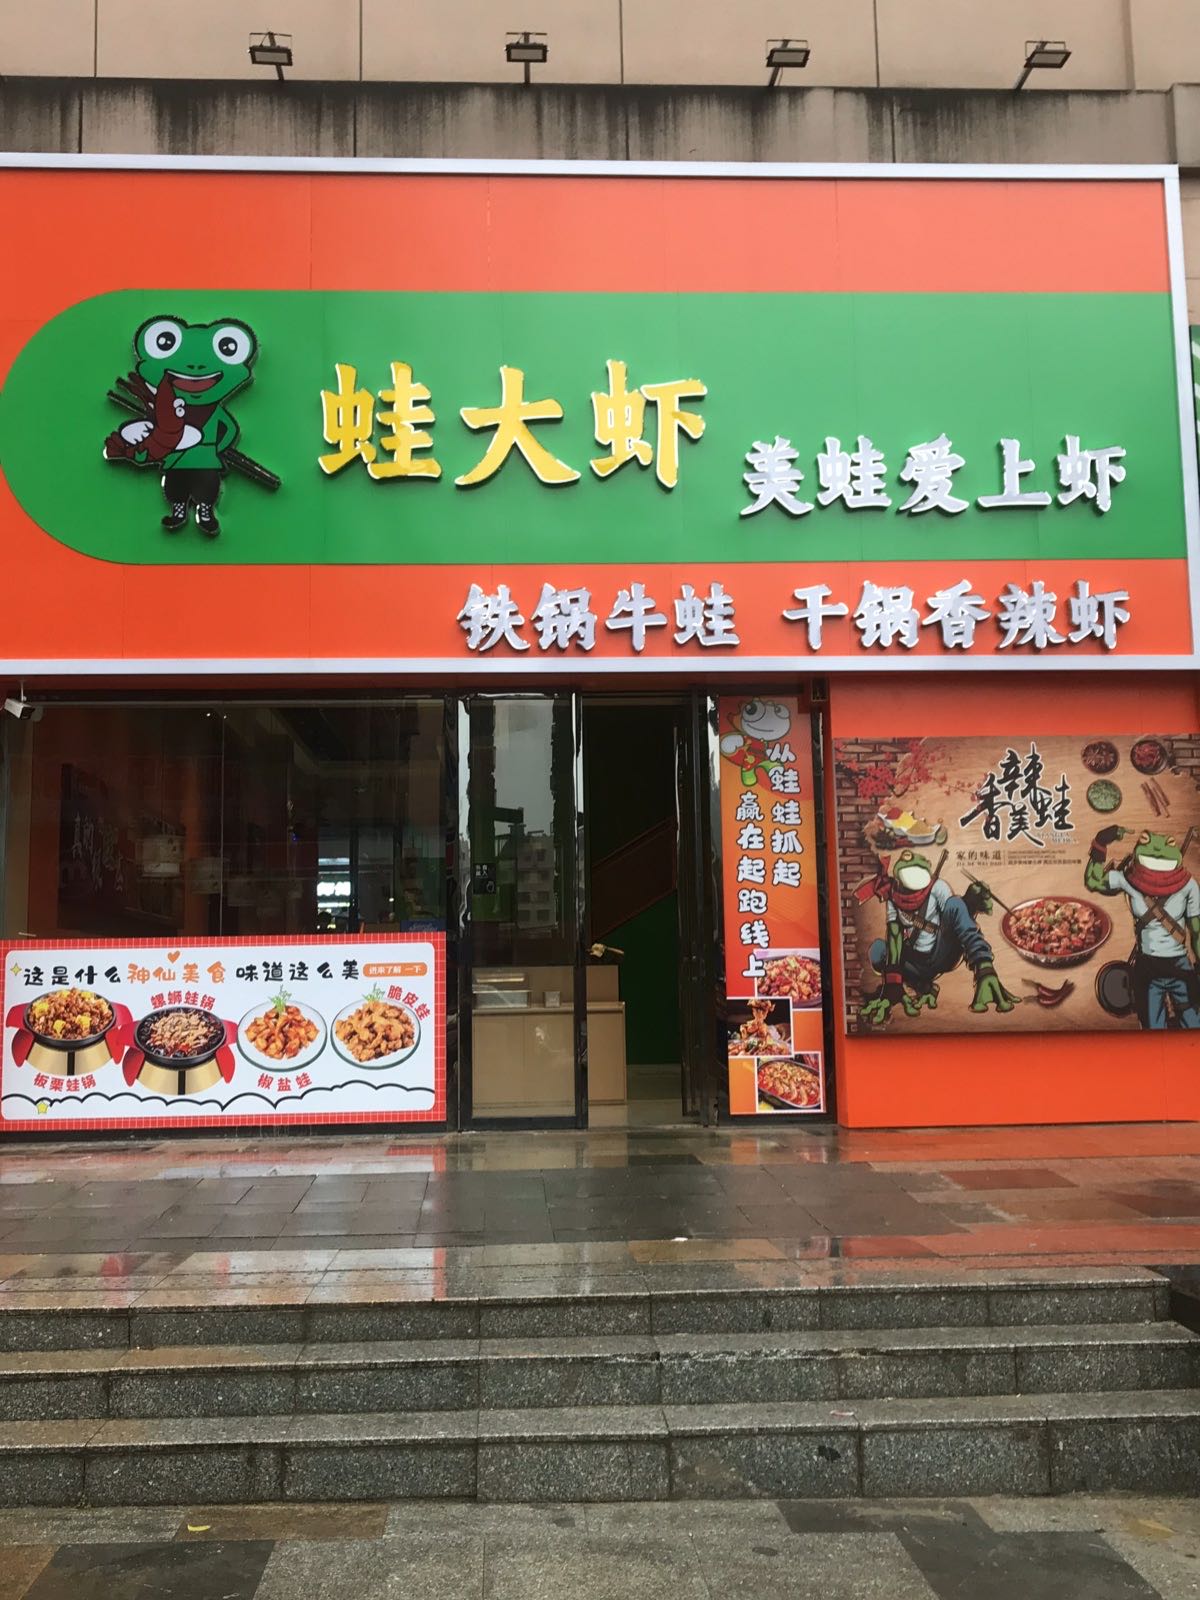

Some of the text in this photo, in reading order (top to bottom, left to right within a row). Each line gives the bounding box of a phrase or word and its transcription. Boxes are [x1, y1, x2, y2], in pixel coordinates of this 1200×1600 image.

[318, 358, 708, 488] 蛙大虾
[739, 432, 1127, 516] 美蛙爱上虾
[456, 579, 1132, 653] 铁锅牛蛙 干锅香辣虾
[767, 743, 803, 888] 从蛙蛙抓起
[736, 791, 770, 978] 赢在起跑线上
[23, 959, 360, 986] 这是什么神仙美食 味道这么美
[387, 984, 430, 1021] 脆皮蛙
[33, 1072, 97, 1092] 板栗蛙锅
[257, 1072, 312, 1092] 椒盐蛙
